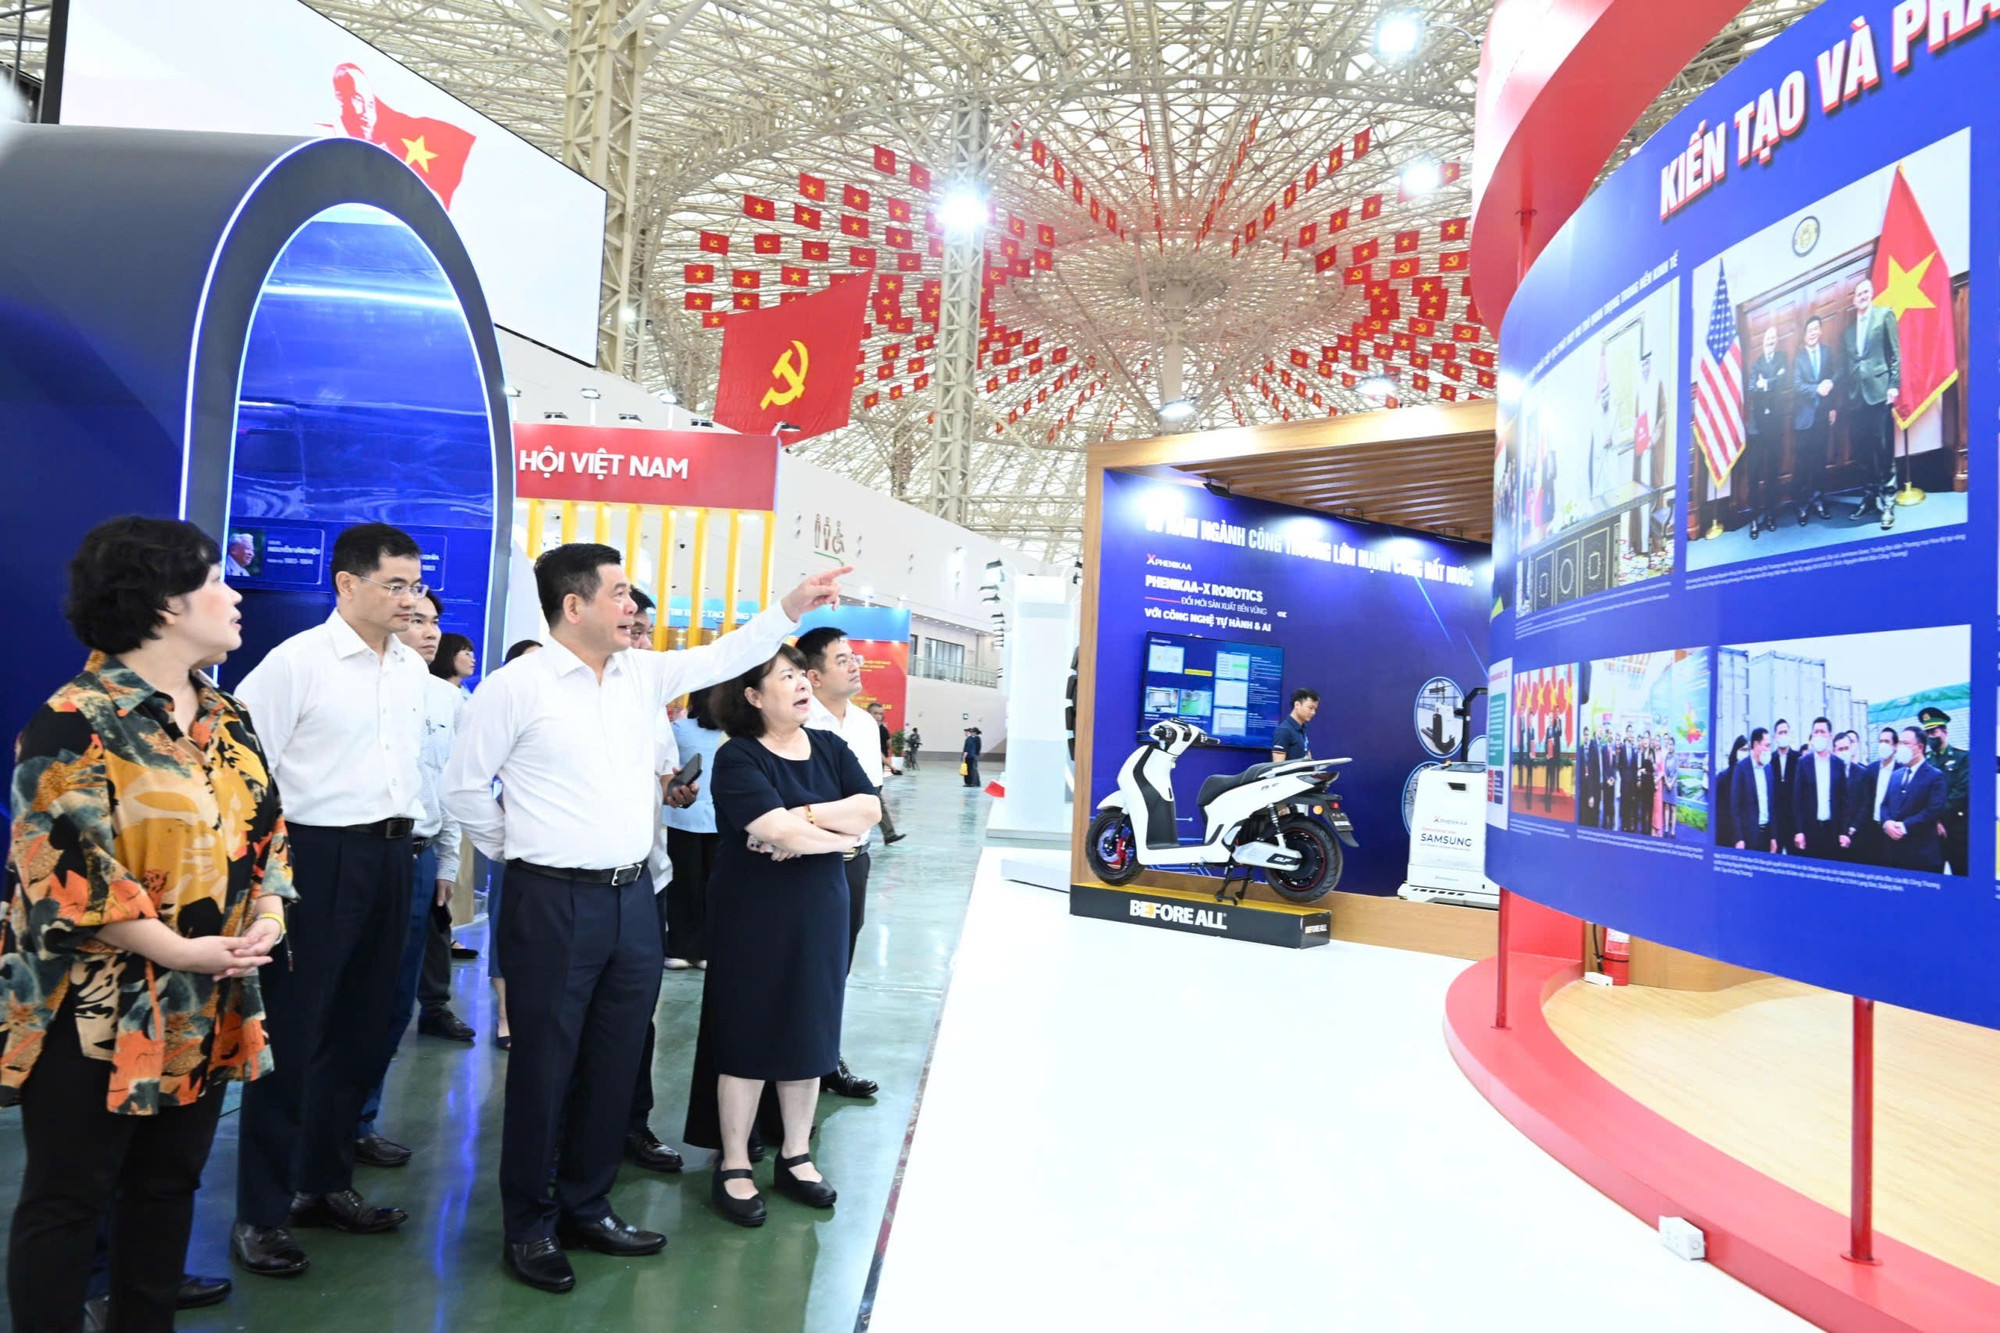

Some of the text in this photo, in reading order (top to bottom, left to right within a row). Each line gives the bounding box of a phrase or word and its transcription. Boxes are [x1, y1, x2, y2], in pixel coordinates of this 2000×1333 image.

[1660, 119, 1726, 220] KIẾN
[1734, 69, 1806, 166] TẠO
[1816, 14, 1880, 114] VÀ
[519, 445, 689, 480] HỘI VIỆT NAM
[1201, 519, 1246, 547] NGÀNH
[1249, 527, 1282, 553] CÔNG
[1145, 574, 1263, 602] PHENIKAA-X ROBOTICS
[1163, 610, 1189, 621] CÔNG
[1190, 613, 1215, 627] NGHỆ
[1216, 616, 1228, 628] TỰ
[1229, 617, 1253, 629] HÀNH
[1262, 623, 1271, 632] AI
[1420, 832, 1472, 847] SAMSUNG
[1129, 899, 1228, 930] BEFORE ALL
